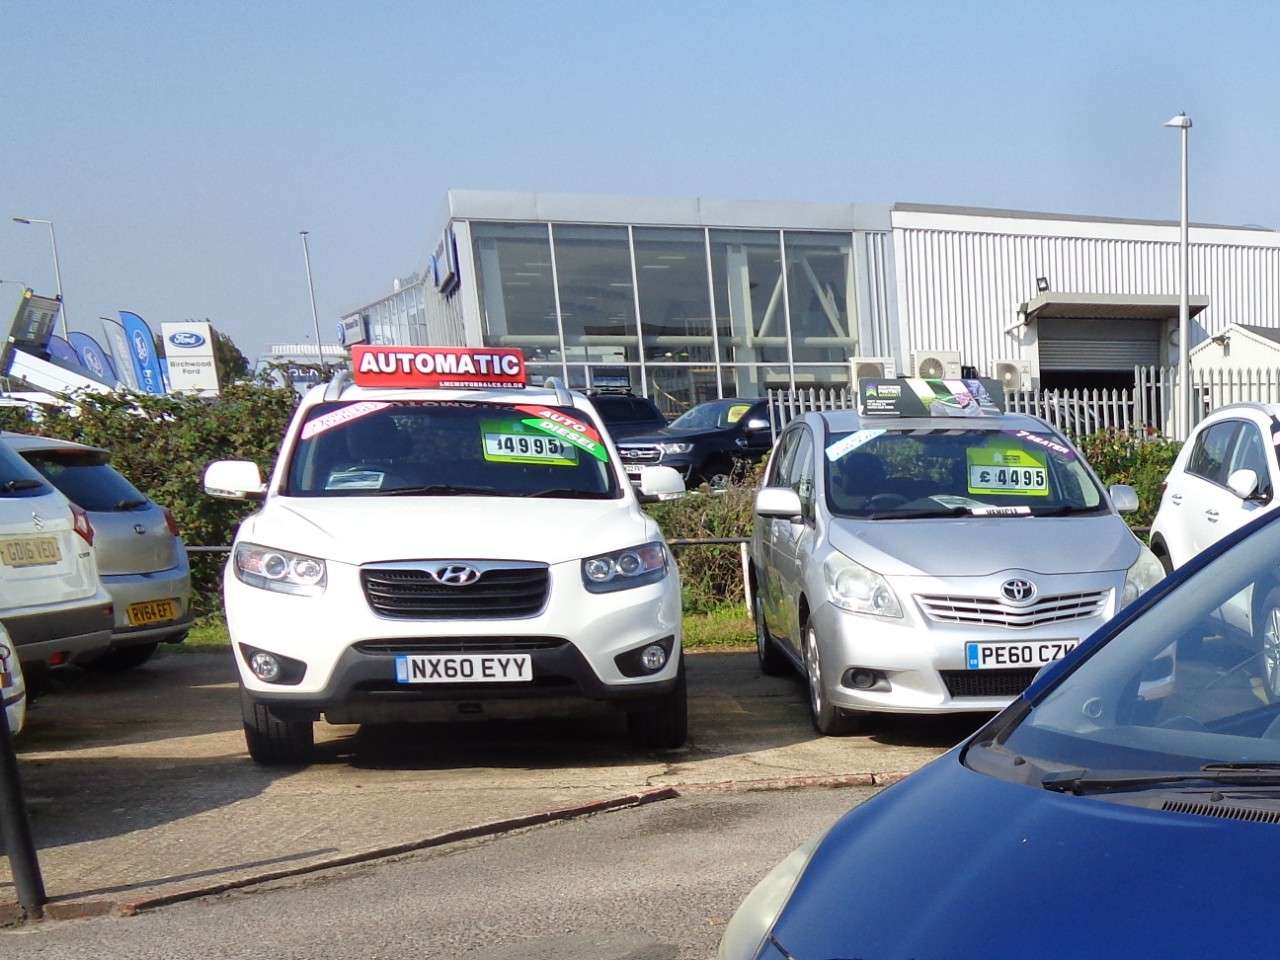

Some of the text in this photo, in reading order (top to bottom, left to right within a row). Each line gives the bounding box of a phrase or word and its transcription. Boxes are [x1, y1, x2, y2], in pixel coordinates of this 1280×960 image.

[170, 360, 212, 368] Birchwood
[360, 352, 520, 375] AUTOMATIC
[539, 410, 586, 432] AUTO
[540, 421, 597, 449] DIESEL
[503, 437, 558, 454] 4995
[998, 470, 1044, 486] 4495
[982, 646, 1033, 664] PE60
[412, 657, 526, 678] NX60 EYY
